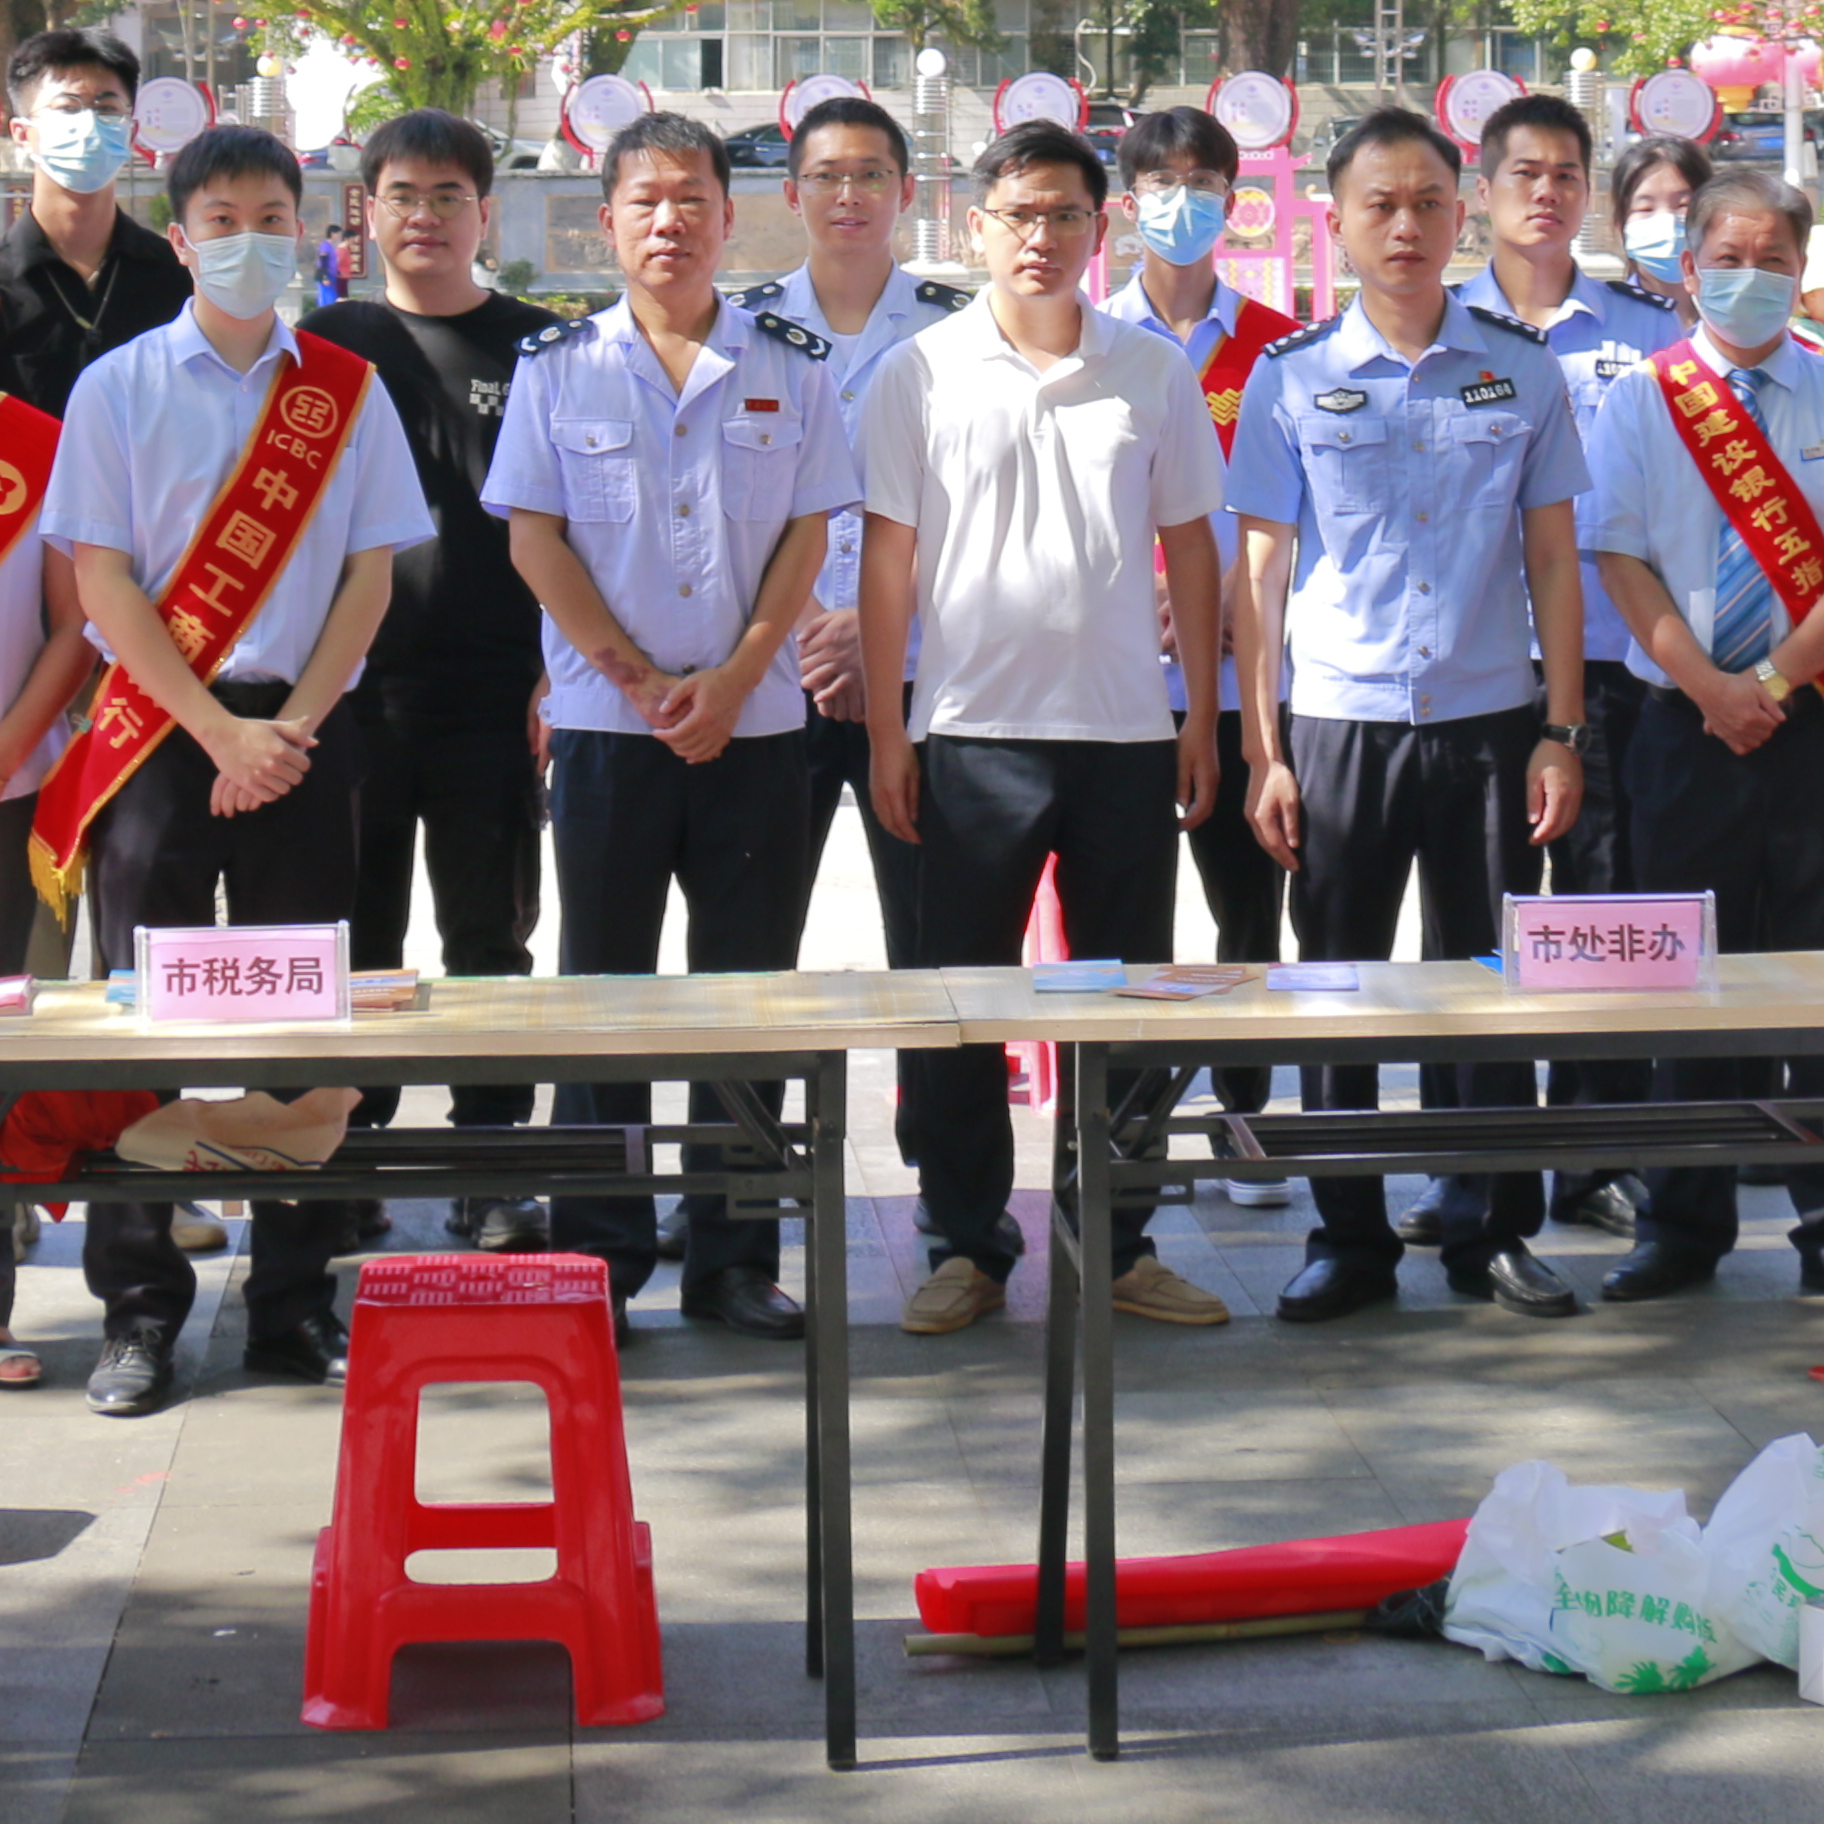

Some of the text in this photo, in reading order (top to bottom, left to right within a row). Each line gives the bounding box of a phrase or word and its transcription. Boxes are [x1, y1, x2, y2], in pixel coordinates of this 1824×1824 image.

[267, 432, 323, 471] ICBC
[97, 465, 299, 749] 中国工商行
[1527, 924, 1686, 964] 市处非办
[161, 956, 324, 997] 市税务局
